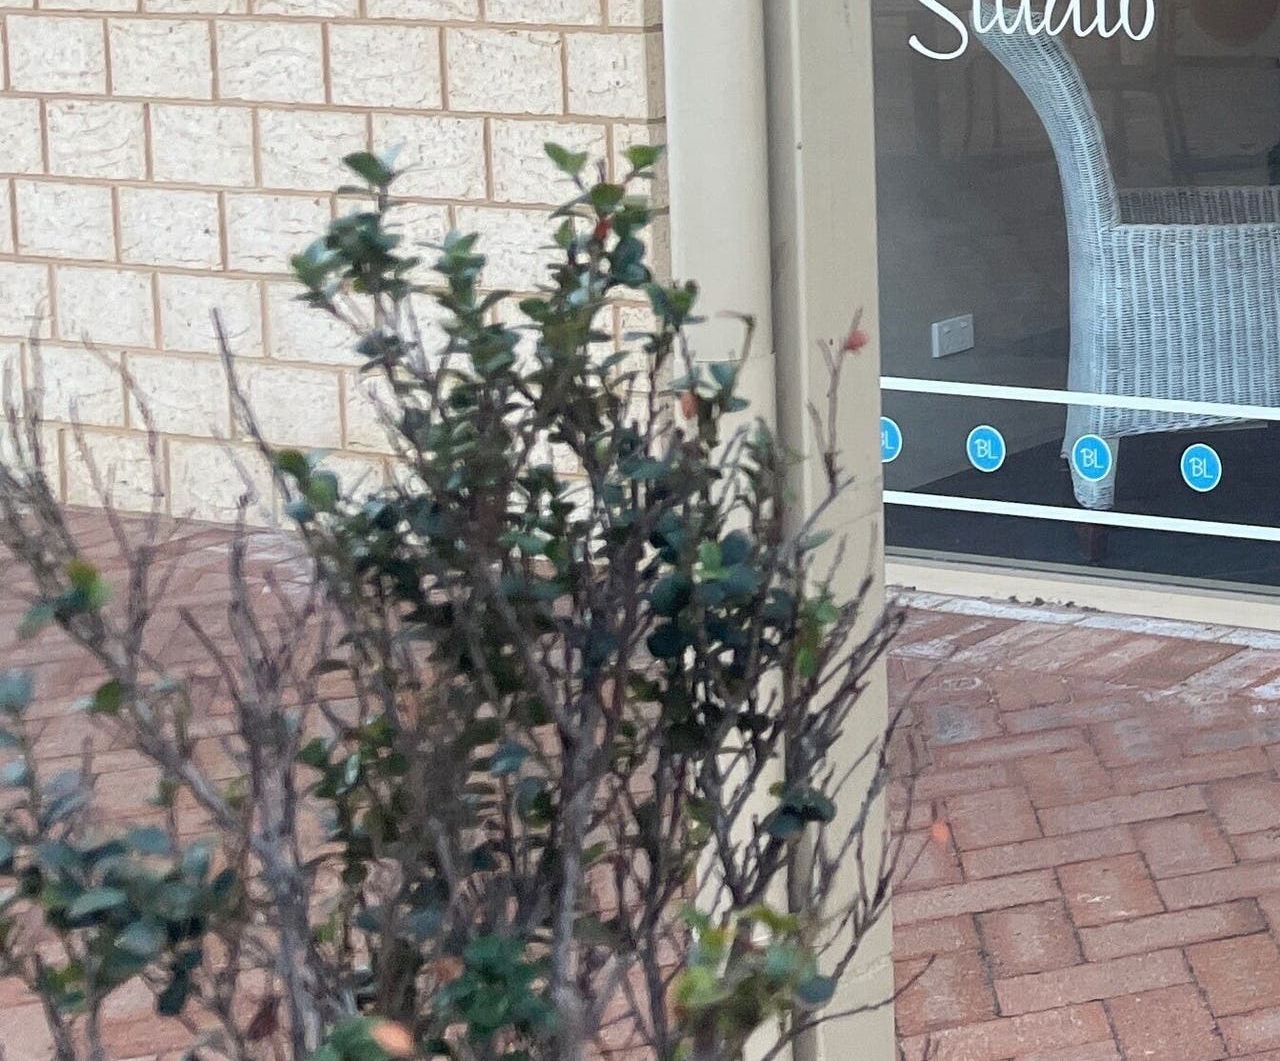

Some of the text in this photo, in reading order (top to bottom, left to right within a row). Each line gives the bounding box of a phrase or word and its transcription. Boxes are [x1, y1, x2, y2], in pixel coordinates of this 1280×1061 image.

[974, 438, 1000, 460] BL
[1079, 447, 1105, 469] BL
[1188, 456, 1214, 479] BL
